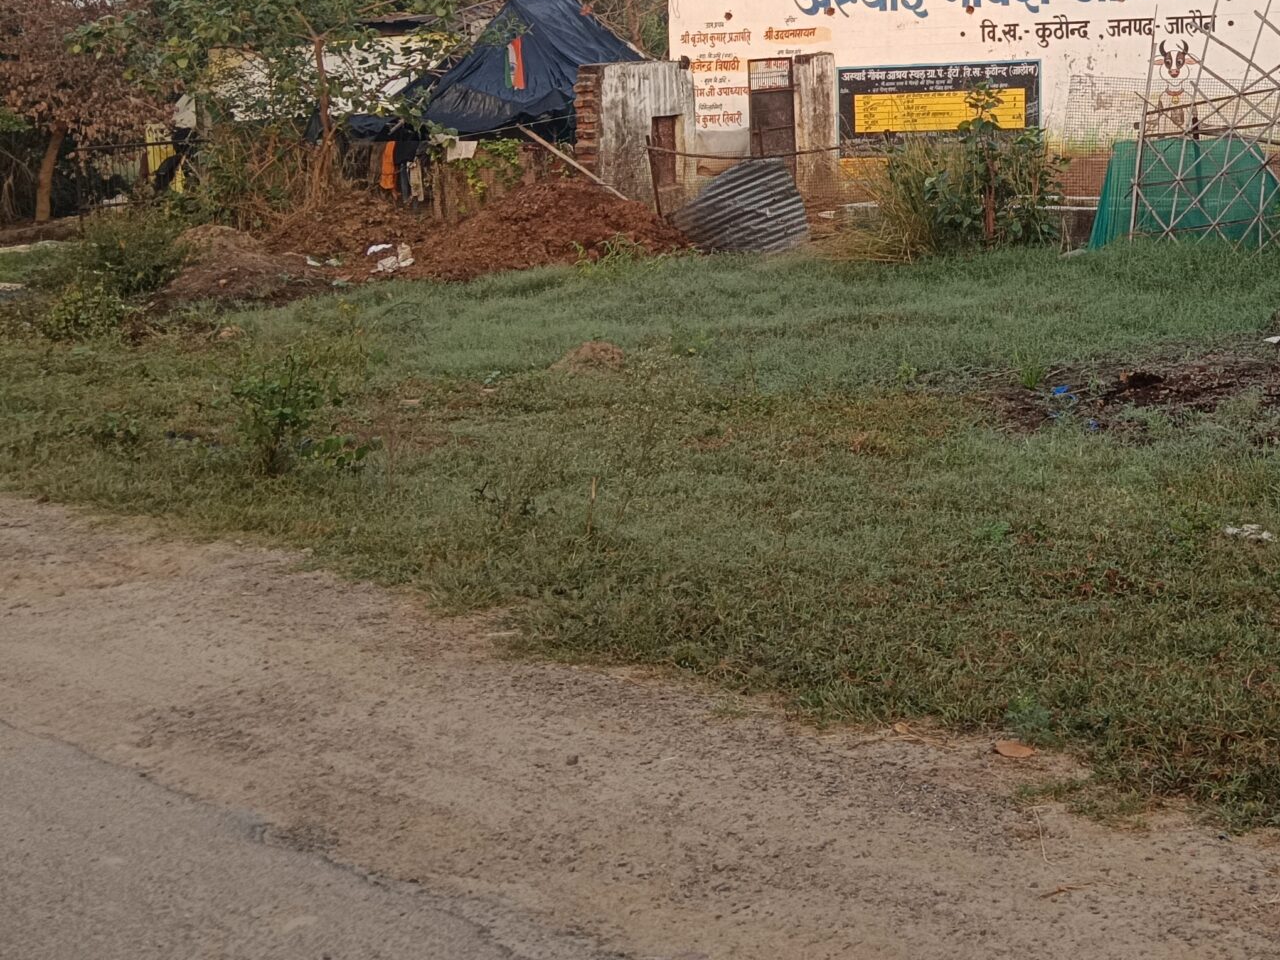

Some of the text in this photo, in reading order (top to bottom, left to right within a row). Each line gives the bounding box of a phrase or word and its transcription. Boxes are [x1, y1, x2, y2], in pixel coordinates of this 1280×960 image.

[680, 30, 690, 45] श्री
[709, 32, 727, 48] कुमार
[764, 27, 773, 40] श्री
[715, 56, 740, 71] त्रिपाठी
[702, 114, 722, 128] कुमार
